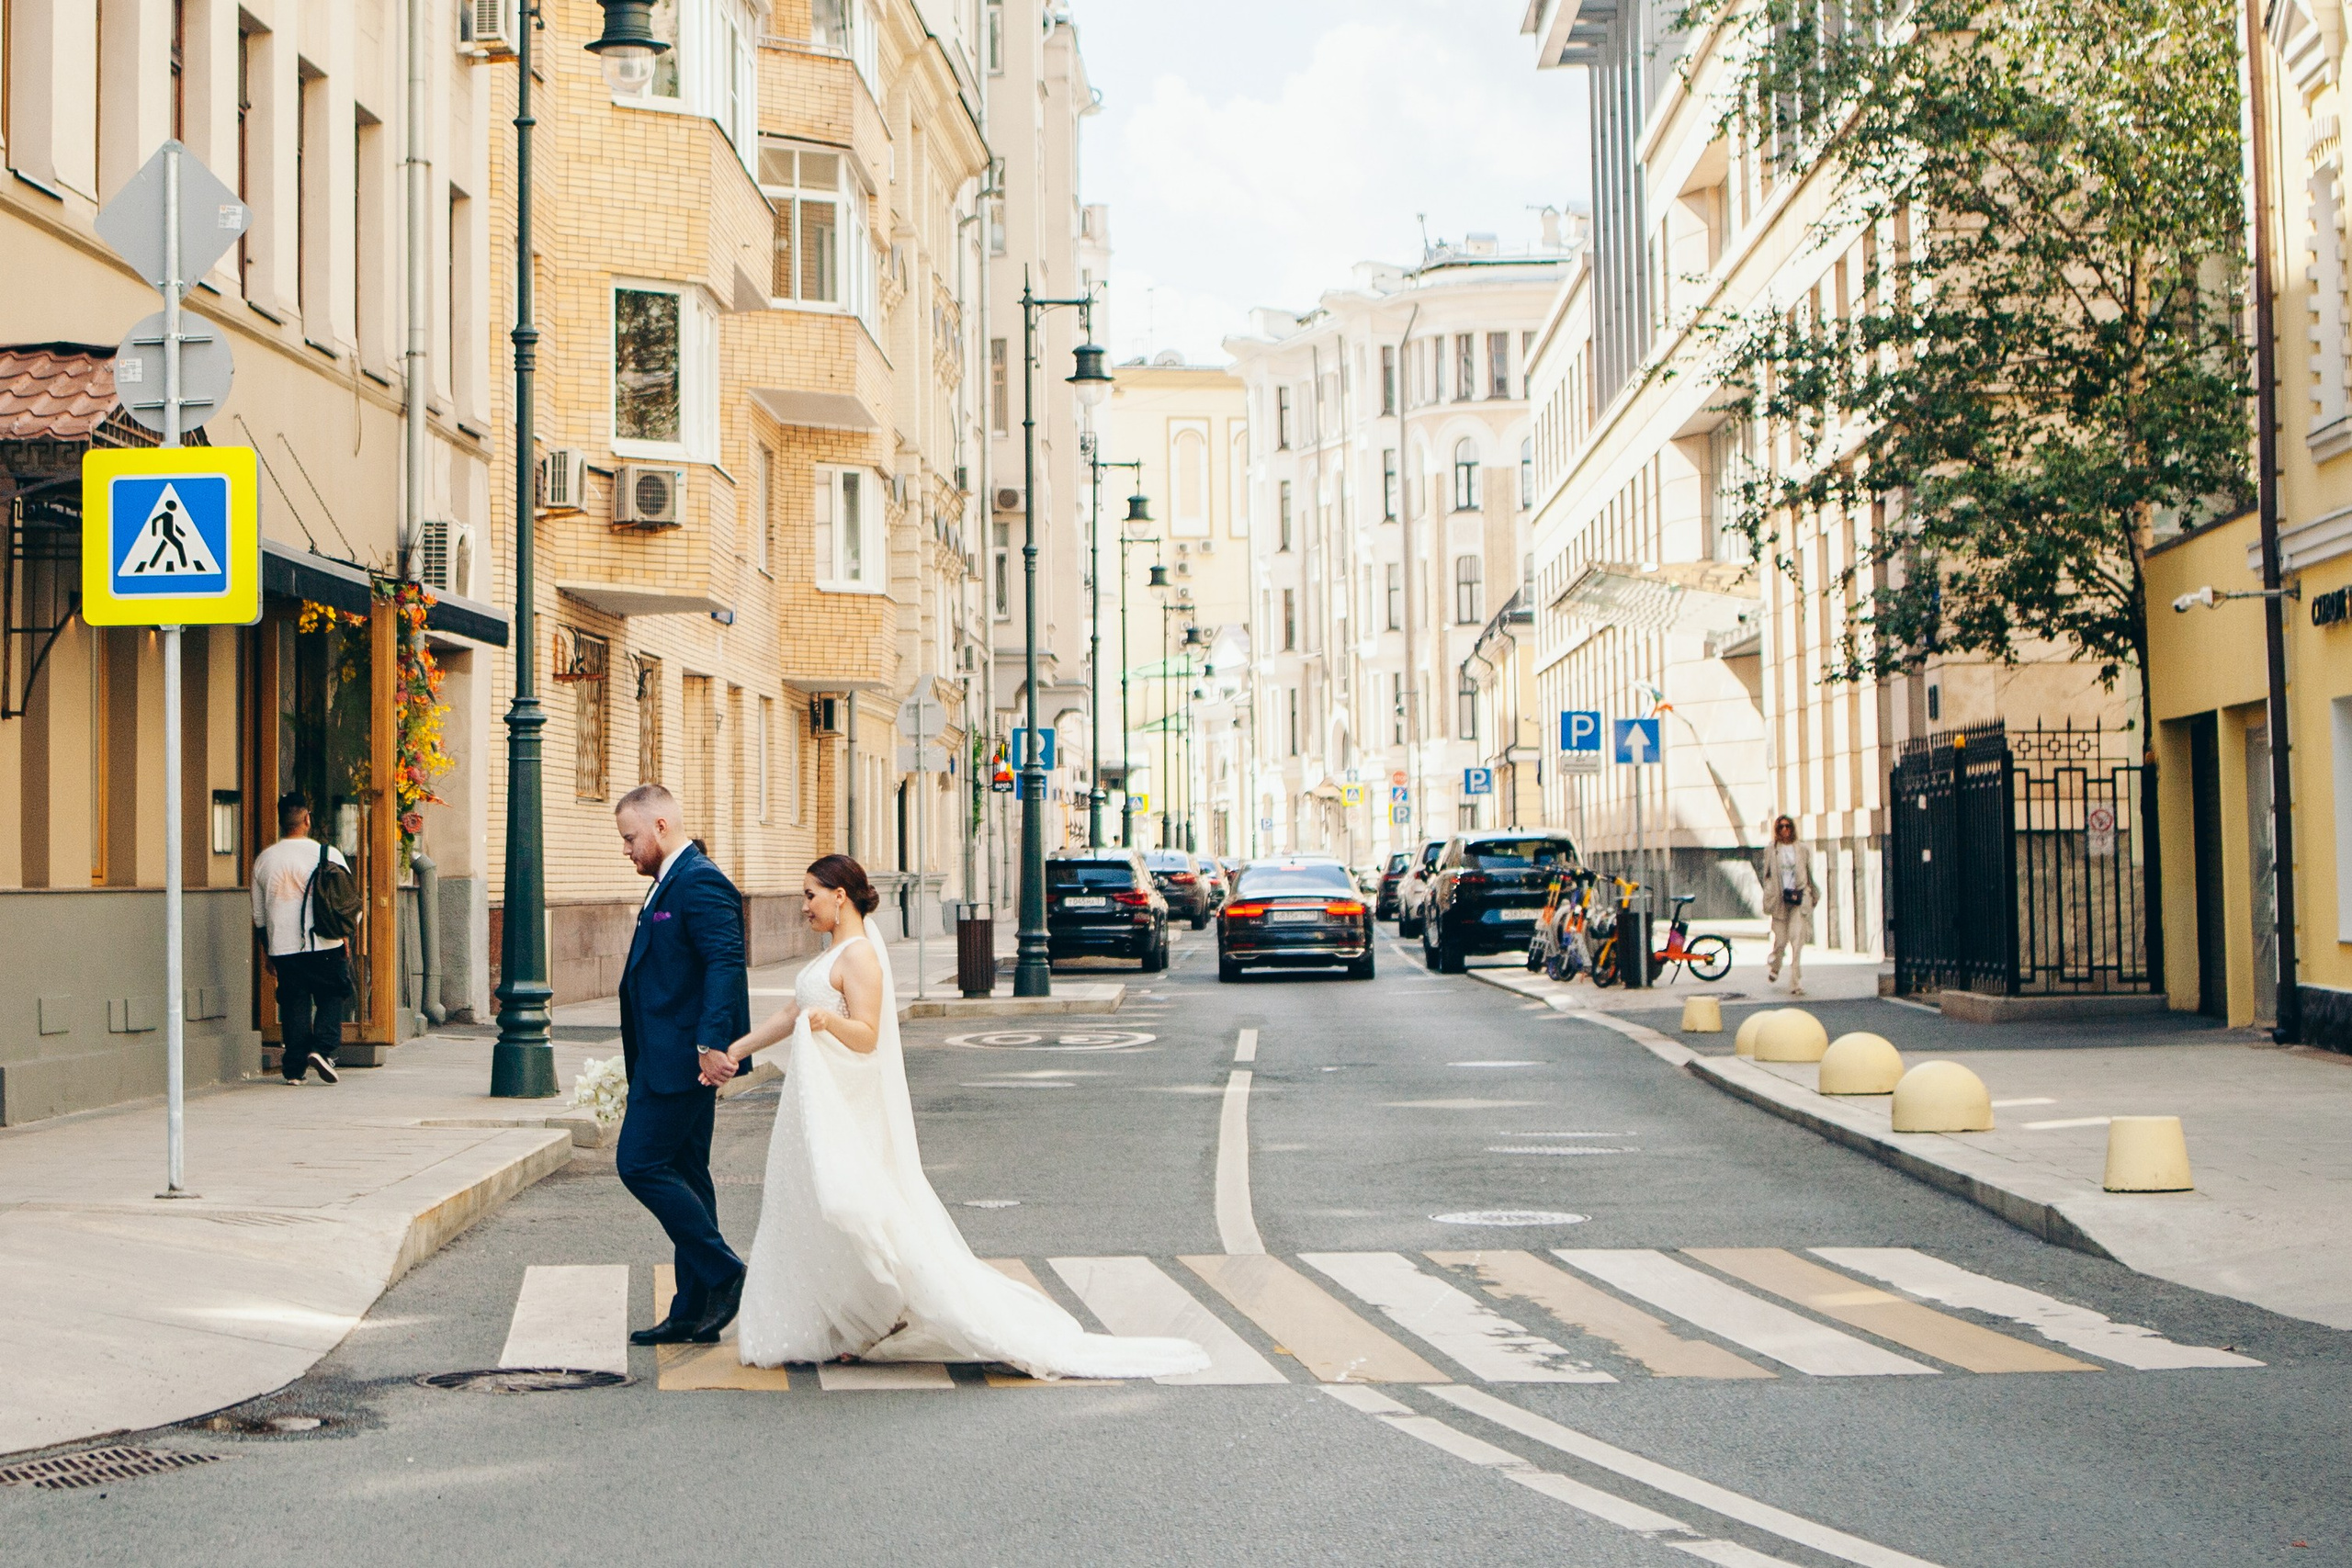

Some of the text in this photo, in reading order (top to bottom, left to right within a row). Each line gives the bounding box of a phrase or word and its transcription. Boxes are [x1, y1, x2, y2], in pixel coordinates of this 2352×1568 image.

[1570, 715, 1595, 748] P
[1470, 770, 1487, 792] P
[1396, 807, 1408, 824] P
